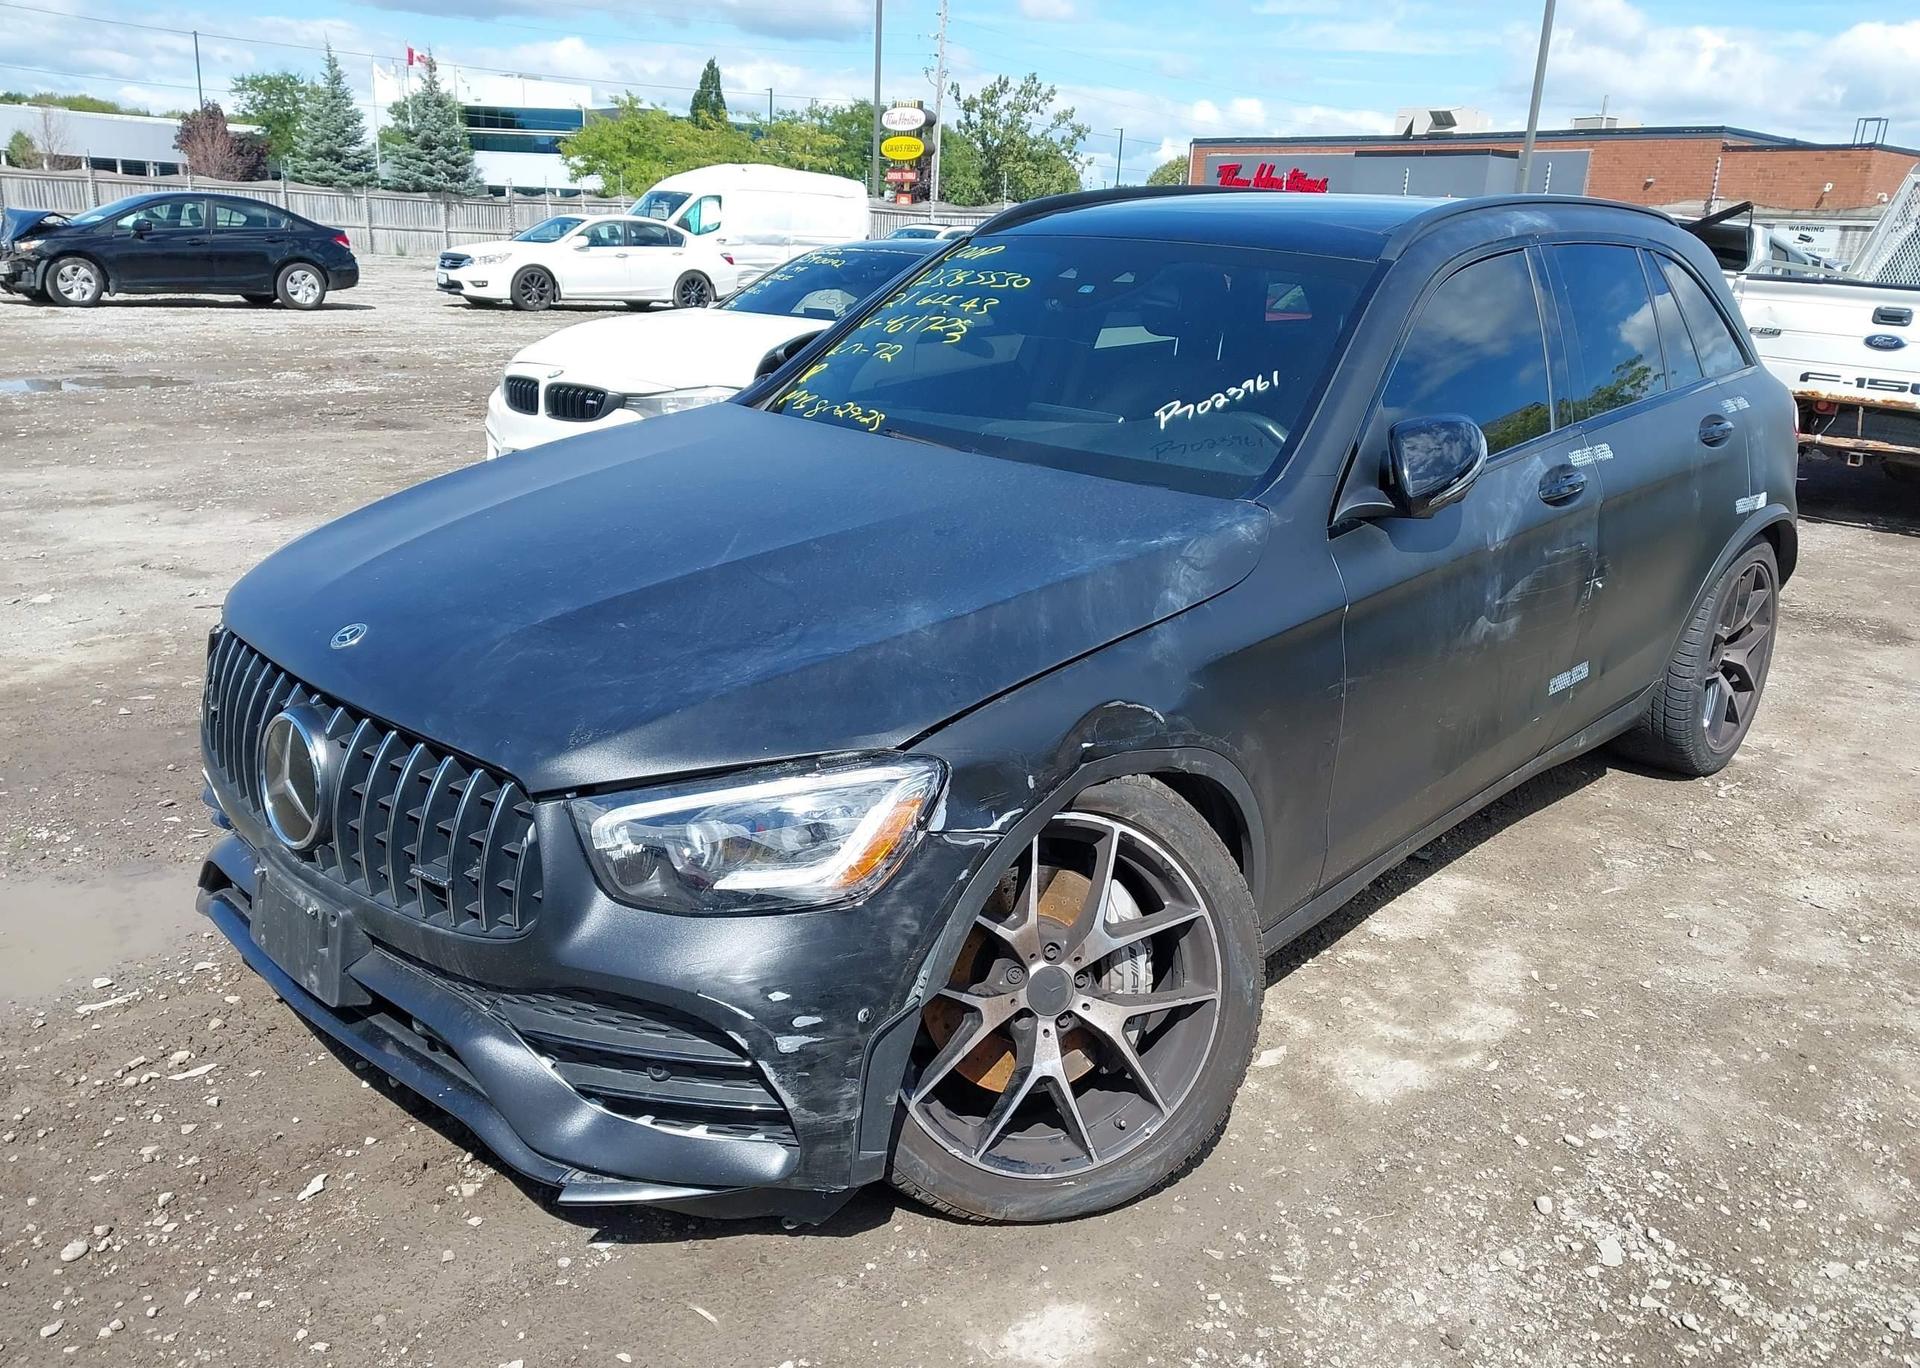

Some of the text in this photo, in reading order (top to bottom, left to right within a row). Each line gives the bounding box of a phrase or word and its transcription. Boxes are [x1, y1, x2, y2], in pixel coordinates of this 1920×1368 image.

[1217, 163, 1252, 187] Tim
[1788, 225, 1825, 233] WARNING
[959, 297, 1000, 315] 43
[1800, 371, 1920, 395] F-15
[1153, 370, 1279, 430] P7023961
